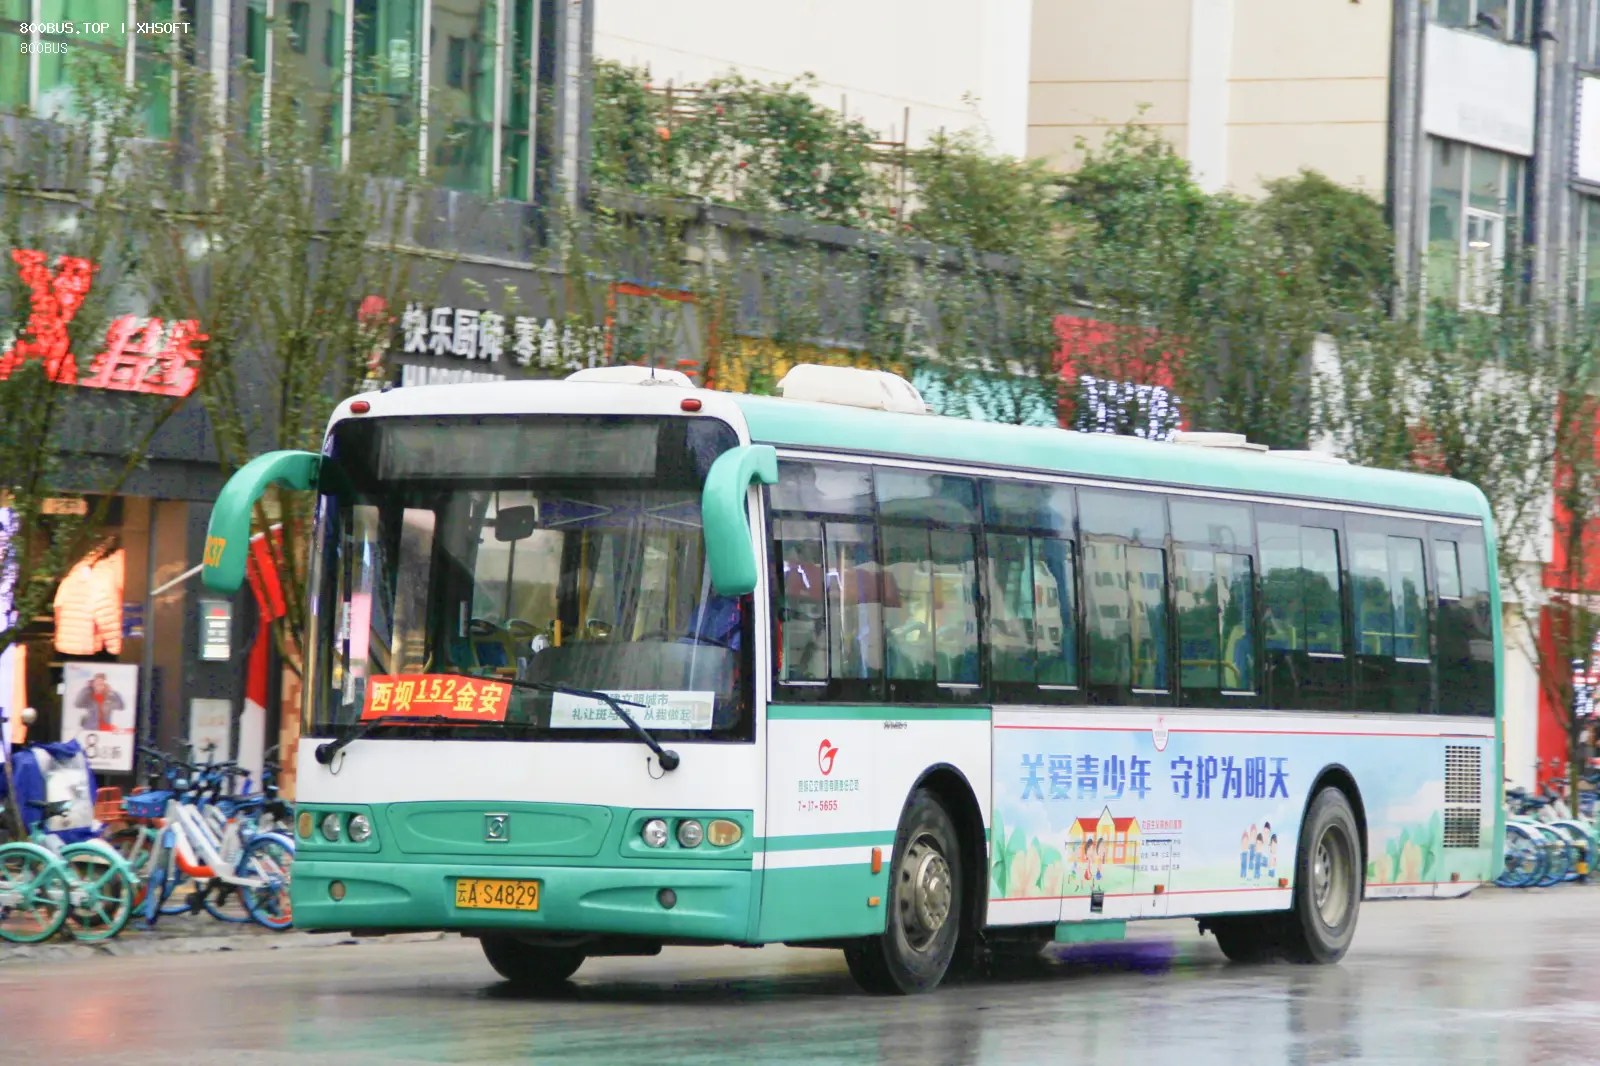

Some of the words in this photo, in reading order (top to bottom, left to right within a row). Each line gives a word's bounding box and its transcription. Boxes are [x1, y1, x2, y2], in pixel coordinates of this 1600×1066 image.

[1020, 754, 1152, 800] 关爱青少年
[1171, 755, 1290, 799] 守护为明天
